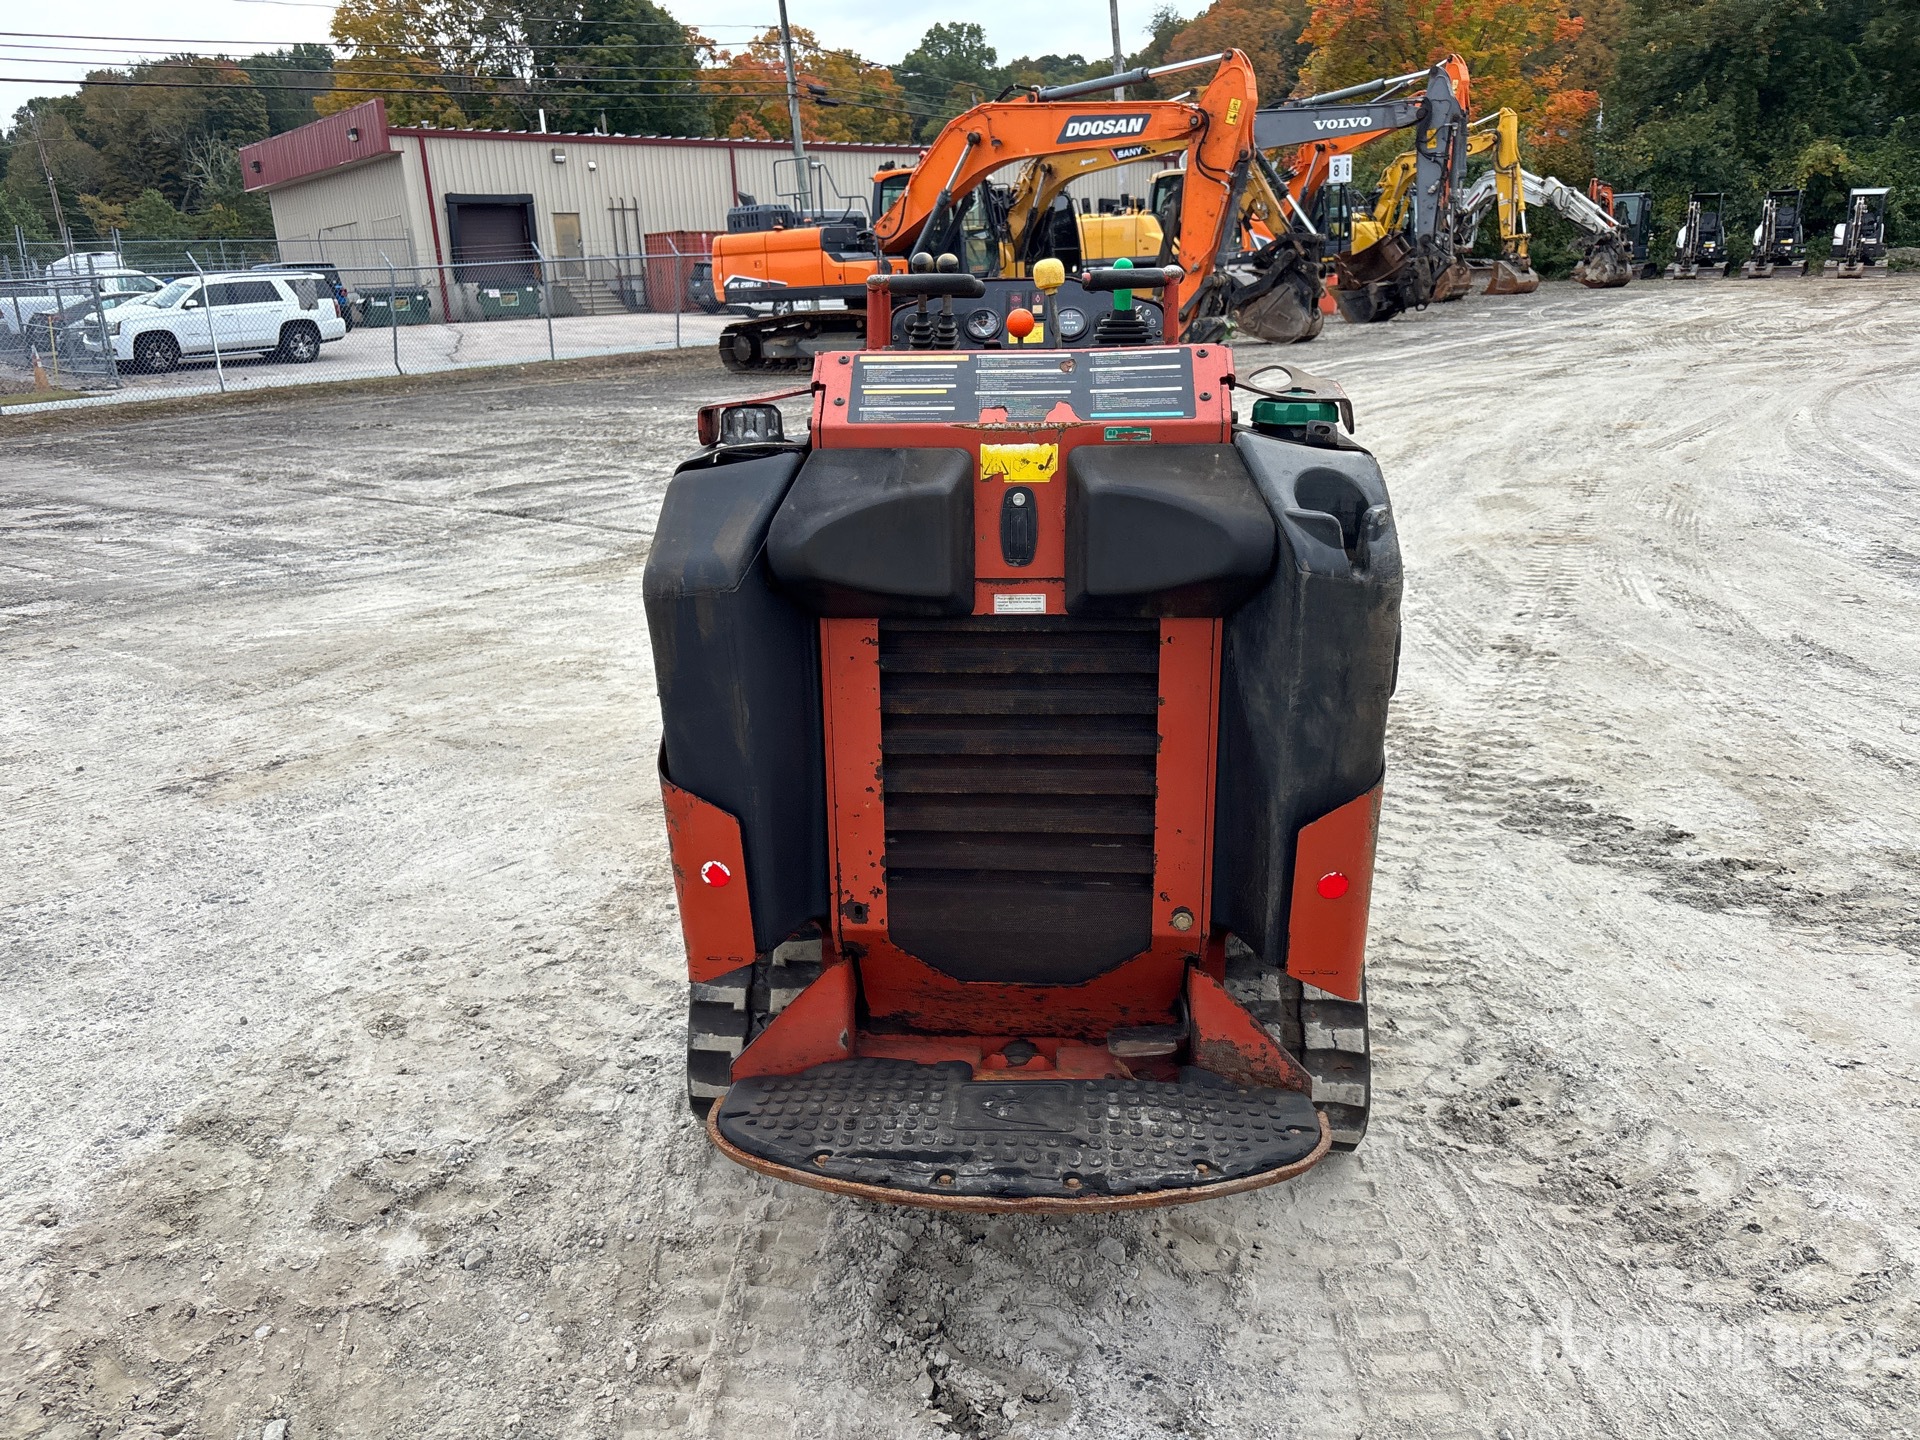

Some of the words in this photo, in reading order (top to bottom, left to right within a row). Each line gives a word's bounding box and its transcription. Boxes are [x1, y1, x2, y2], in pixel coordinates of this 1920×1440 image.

[1065, 117, 1145, 137] DOOSAN
[1313, 116, 1373, 131] VOLVO
[1116, 146, 1143, 159] SANY
[1333, 164, 1340, 178] 8
